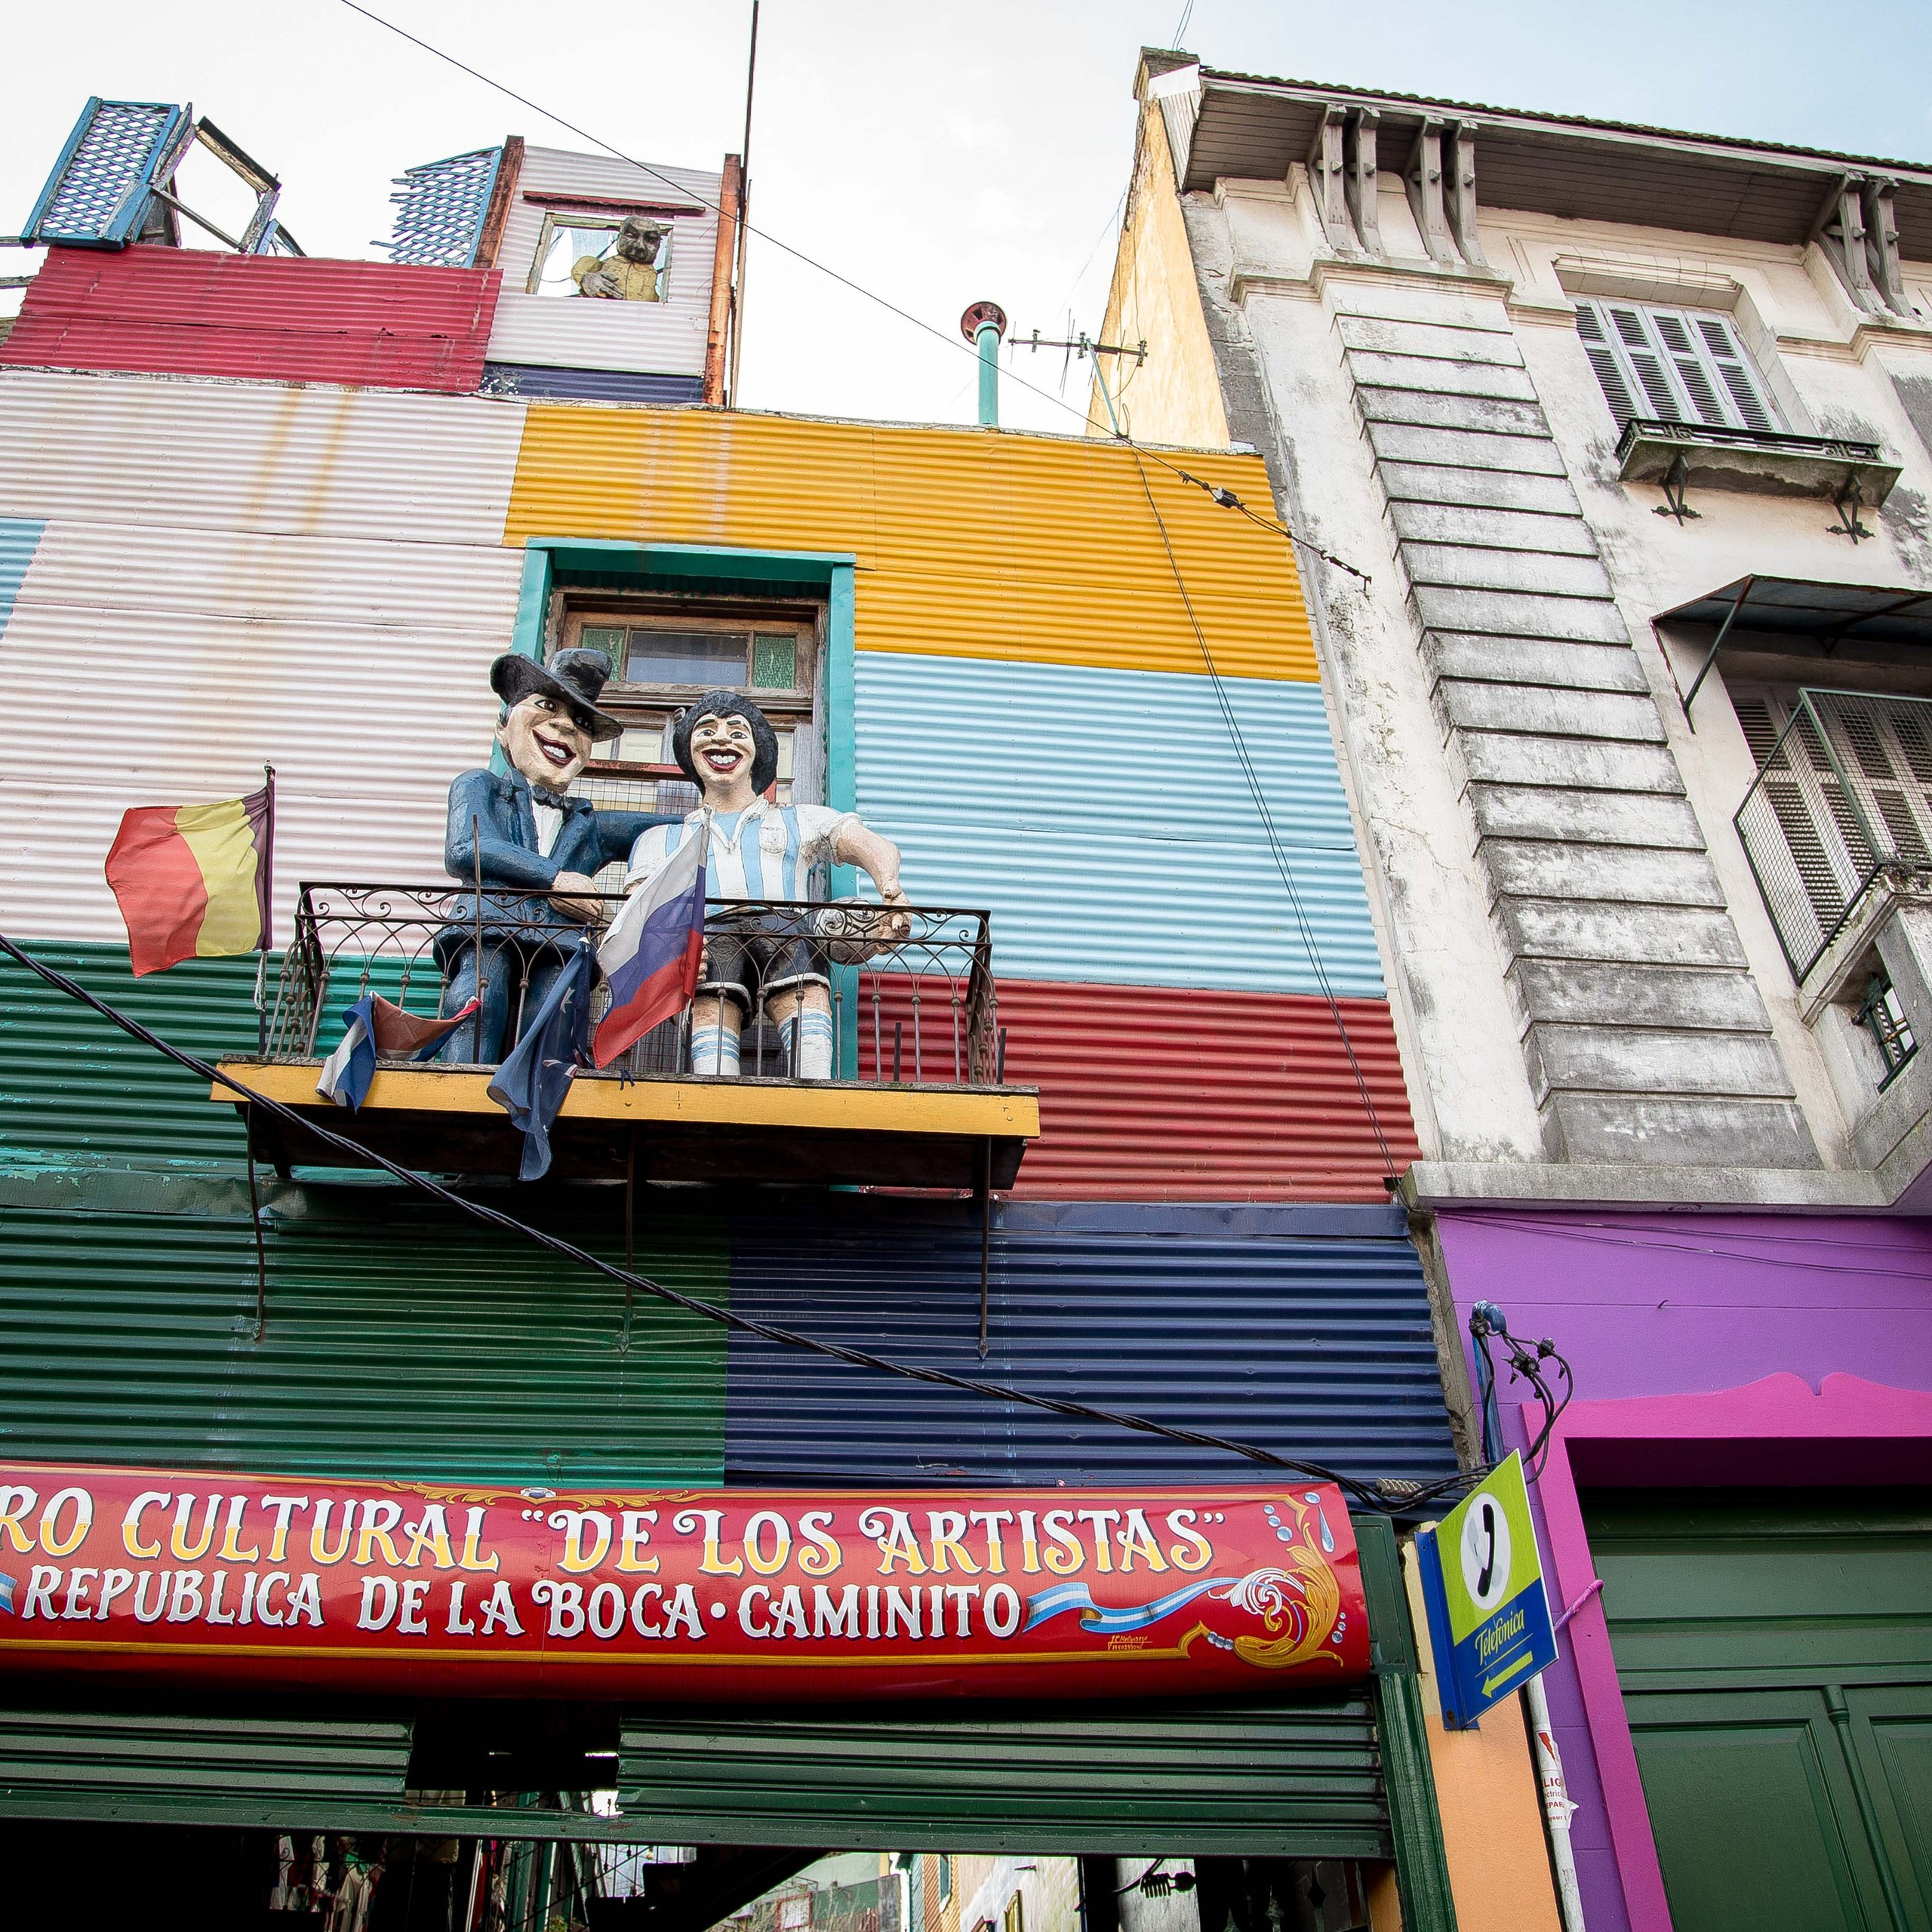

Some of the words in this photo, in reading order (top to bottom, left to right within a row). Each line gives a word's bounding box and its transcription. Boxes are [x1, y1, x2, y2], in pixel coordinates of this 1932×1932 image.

[0, 1484, 94, 1557] RO
[121, 1491, 500, 1574] CULTURAL
[672, 1509, 843, 1578] LOS
[20, 1564, 325, 1628] REPUBLICA
[356, 1574, 432, 1637] DE
[445, 1580, 526, 1637] LA
[531, 1579, 709, 1641] BOCA
[737, 1583, 1022, 1639] CAMINITO
